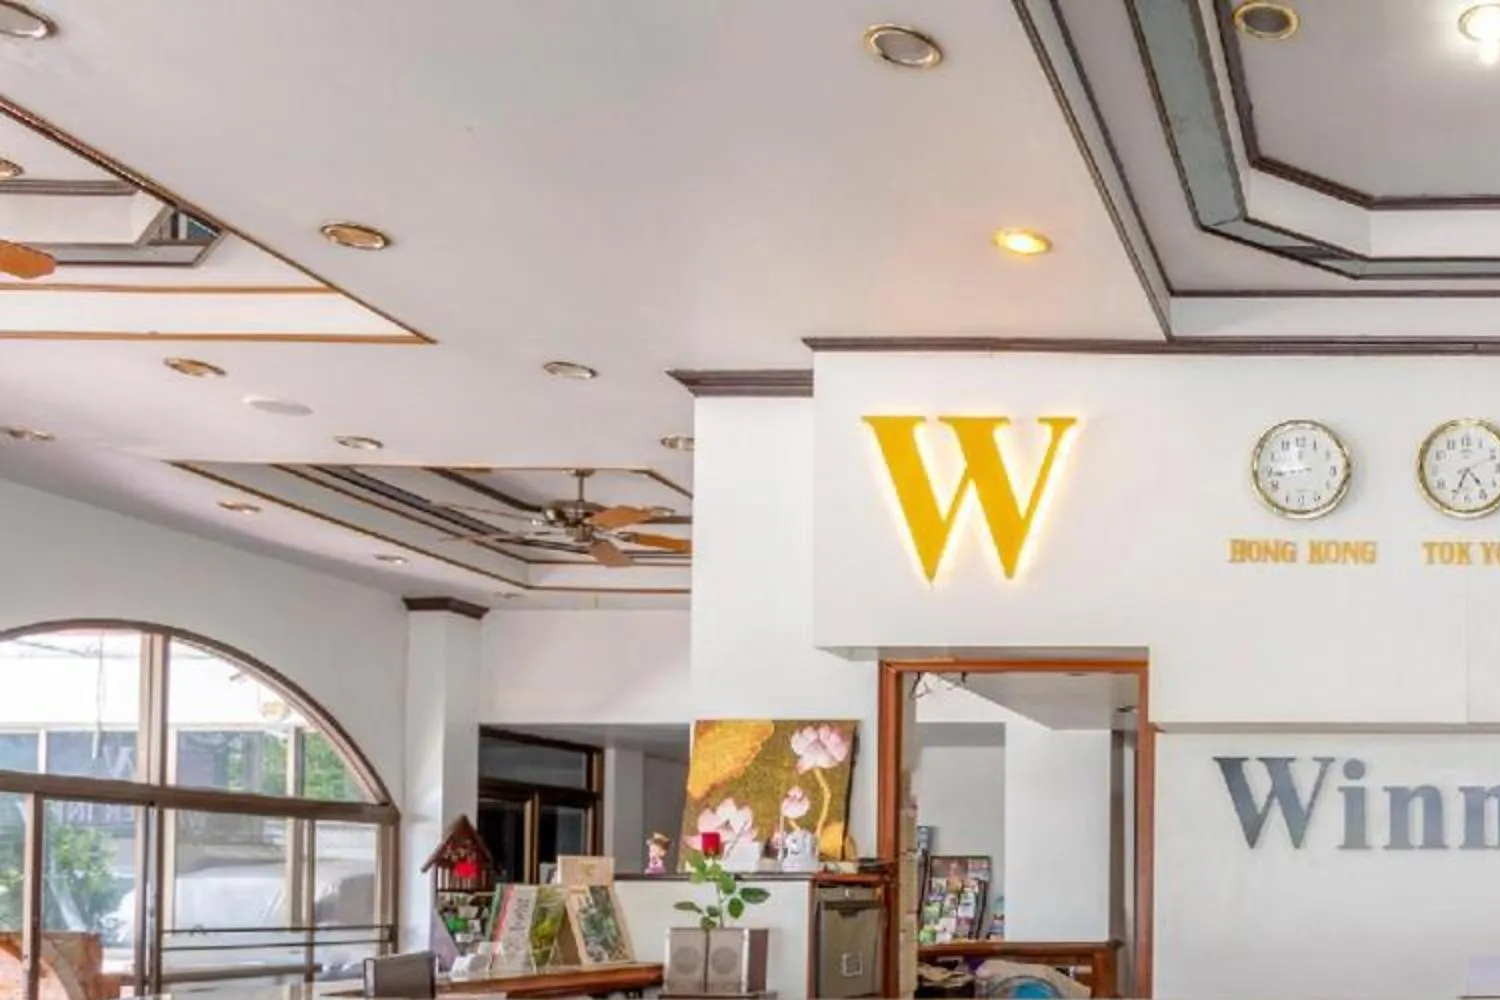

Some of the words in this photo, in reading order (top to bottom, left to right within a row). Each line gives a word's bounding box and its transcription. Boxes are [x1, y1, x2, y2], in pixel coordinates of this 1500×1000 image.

[860, 415, 1079, 586] W
[1228, 539, 1296, 563] HONG
[1308, 540, 1377, 564] KONG
